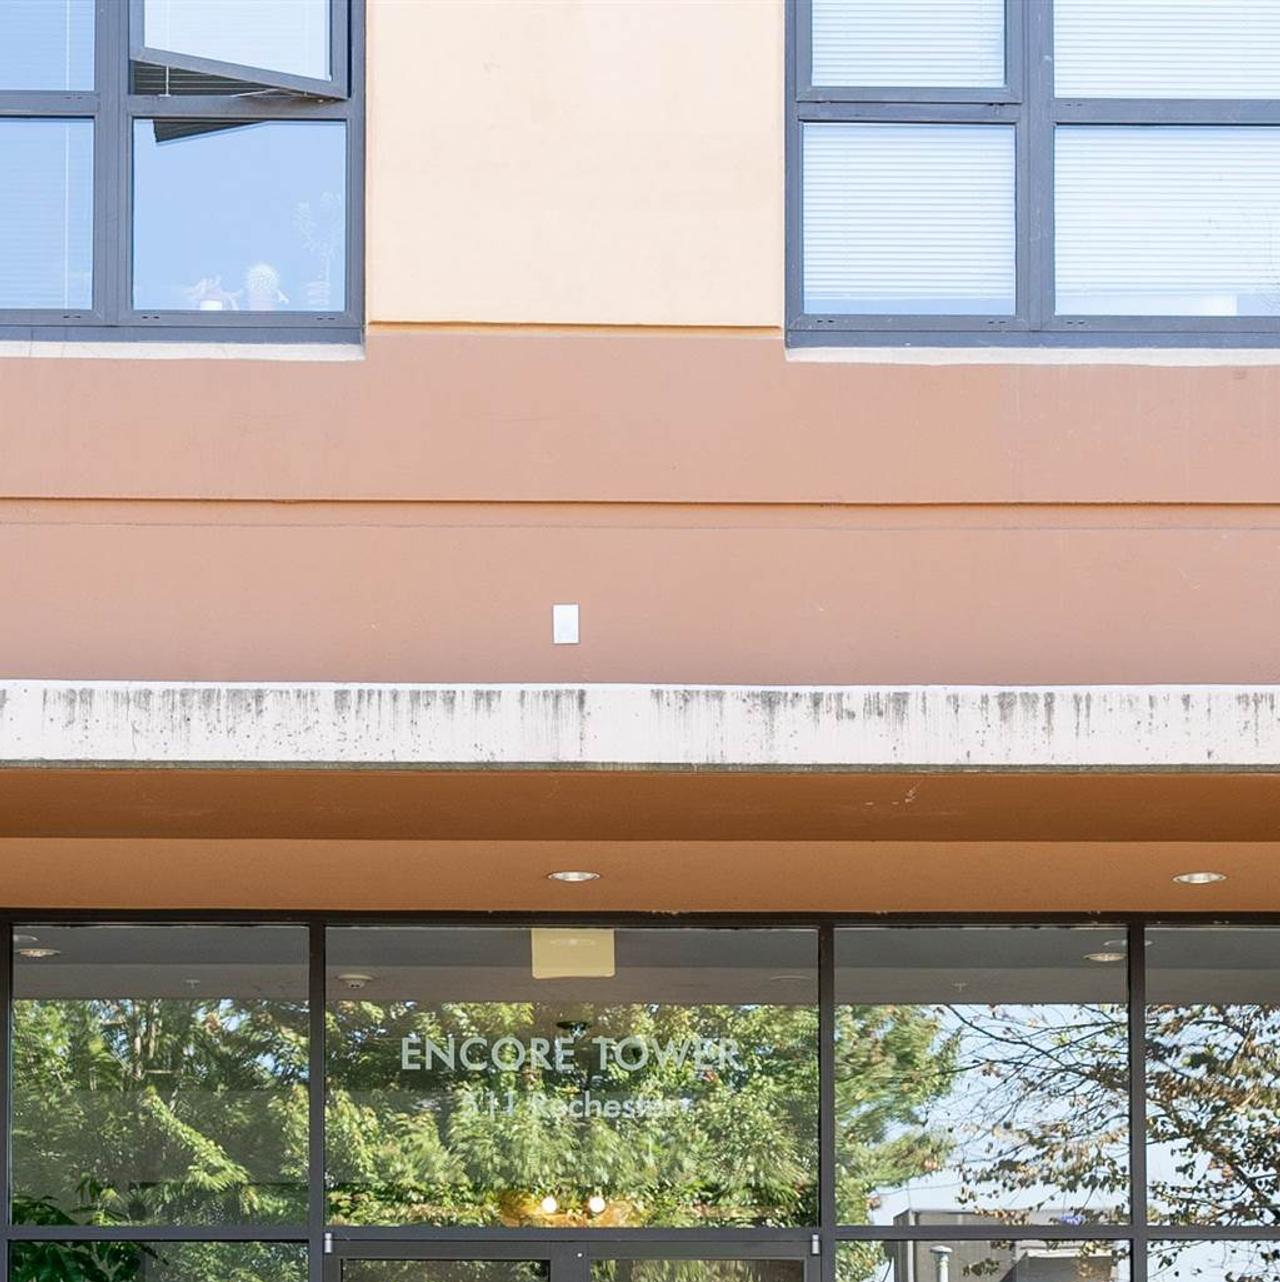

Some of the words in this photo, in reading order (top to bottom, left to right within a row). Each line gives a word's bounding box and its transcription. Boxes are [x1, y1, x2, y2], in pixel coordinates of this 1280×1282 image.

[401, 1036, 575, 1071] ENCORE
[591, 1036, 746, 1071] TOWER
[532, 1090, 677, 1118] Rochester
